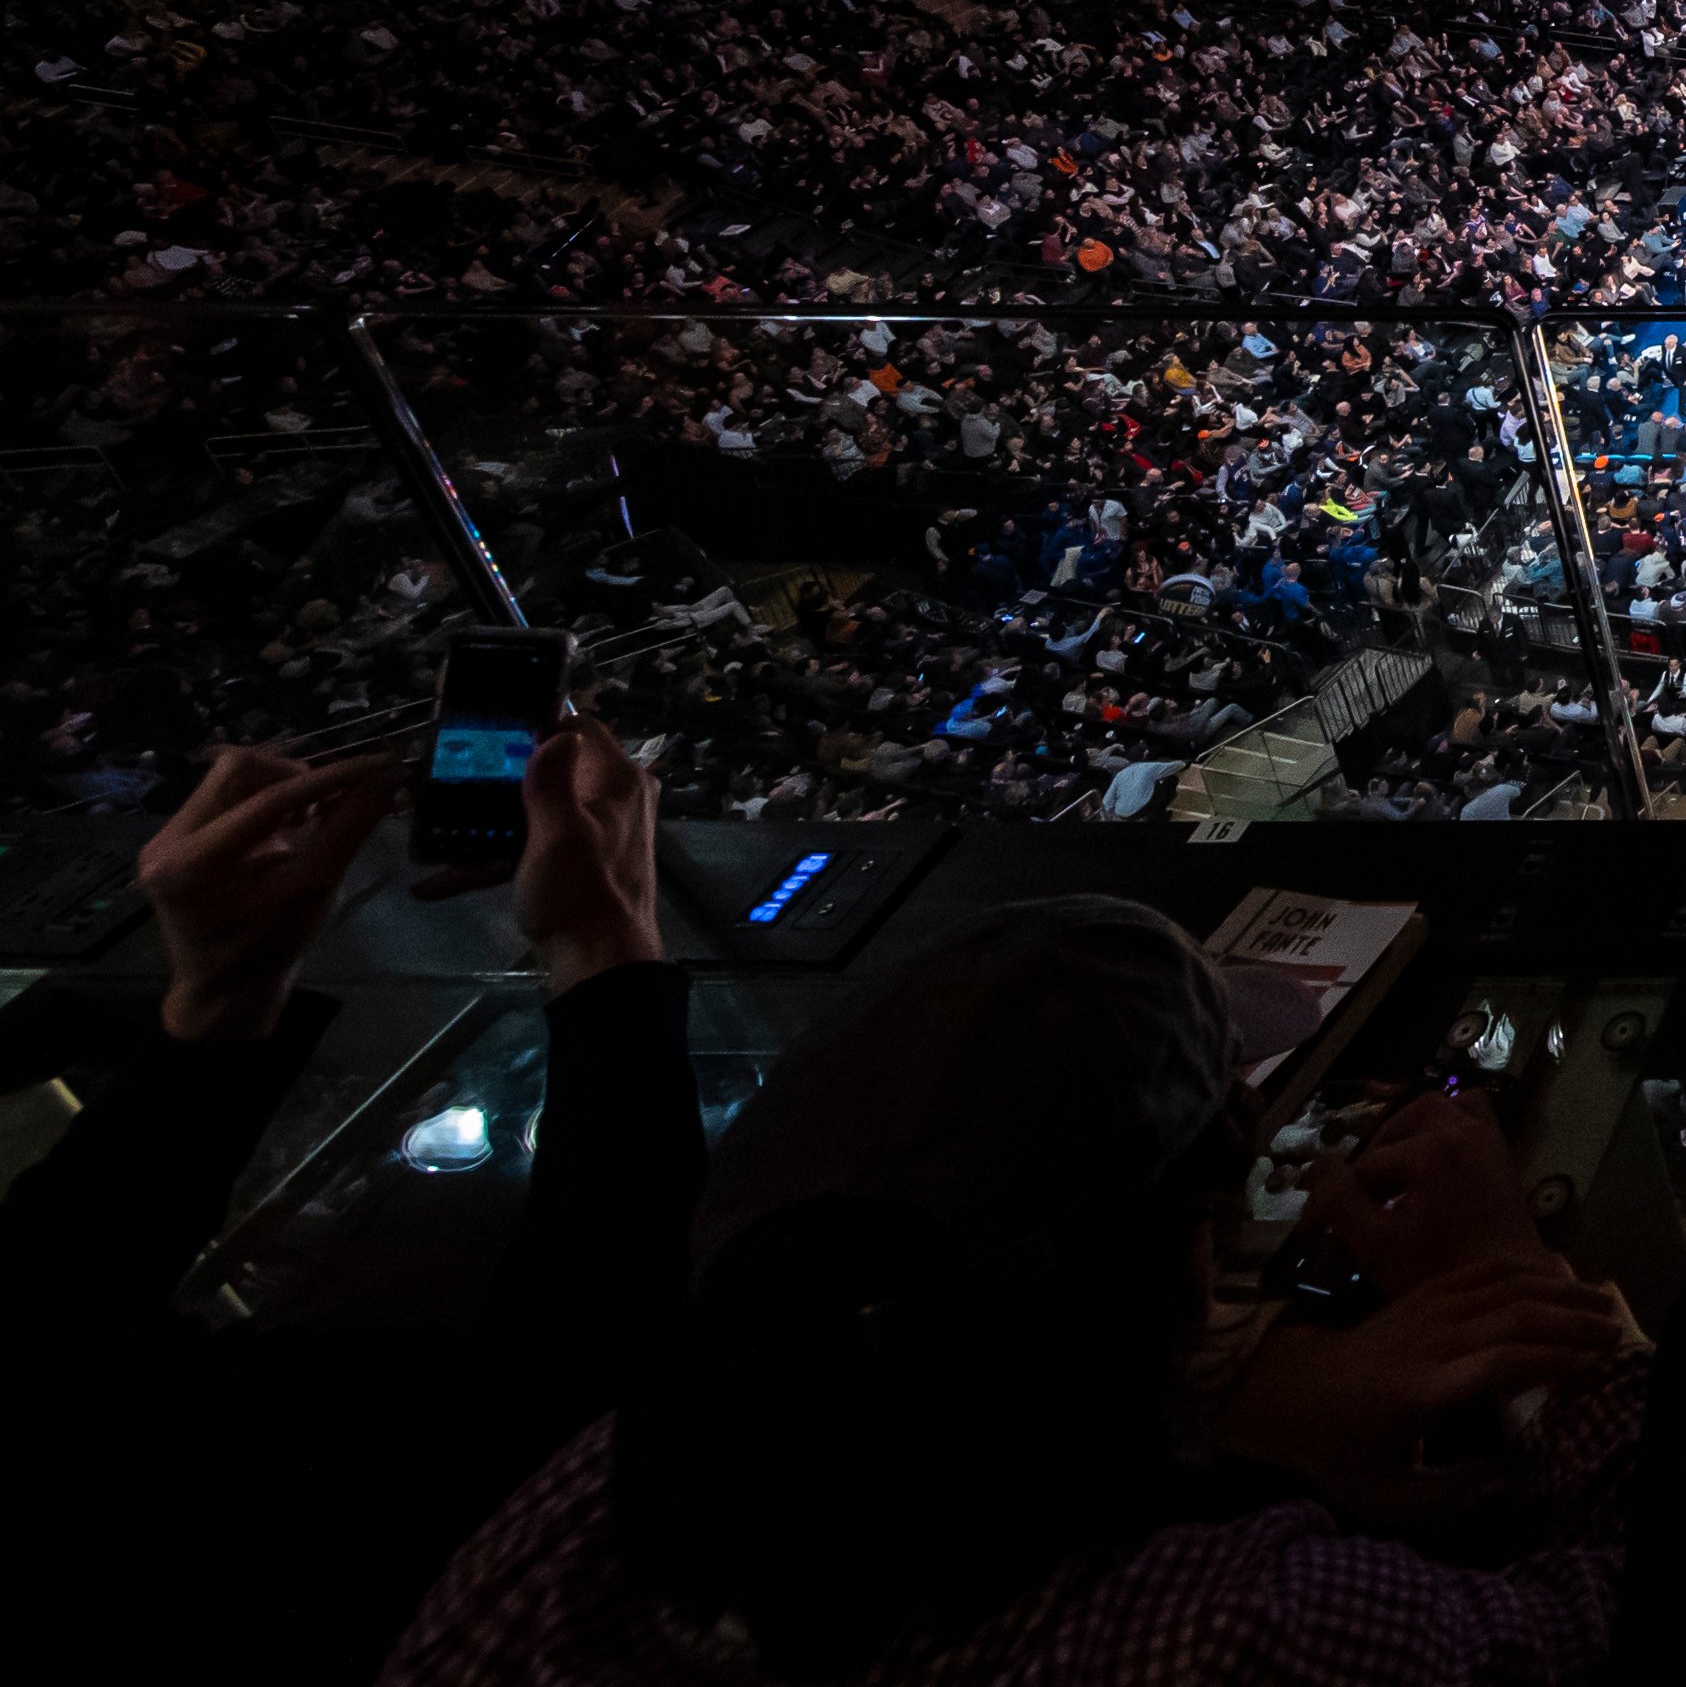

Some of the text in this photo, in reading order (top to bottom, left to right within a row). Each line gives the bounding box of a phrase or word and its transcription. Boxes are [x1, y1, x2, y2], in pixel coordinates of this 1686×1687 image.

[1206, 821, 1235, 840] 16
[1269, 906, 1338, 931] JOHN
[1249, 930, 1323, 957] FANTE
